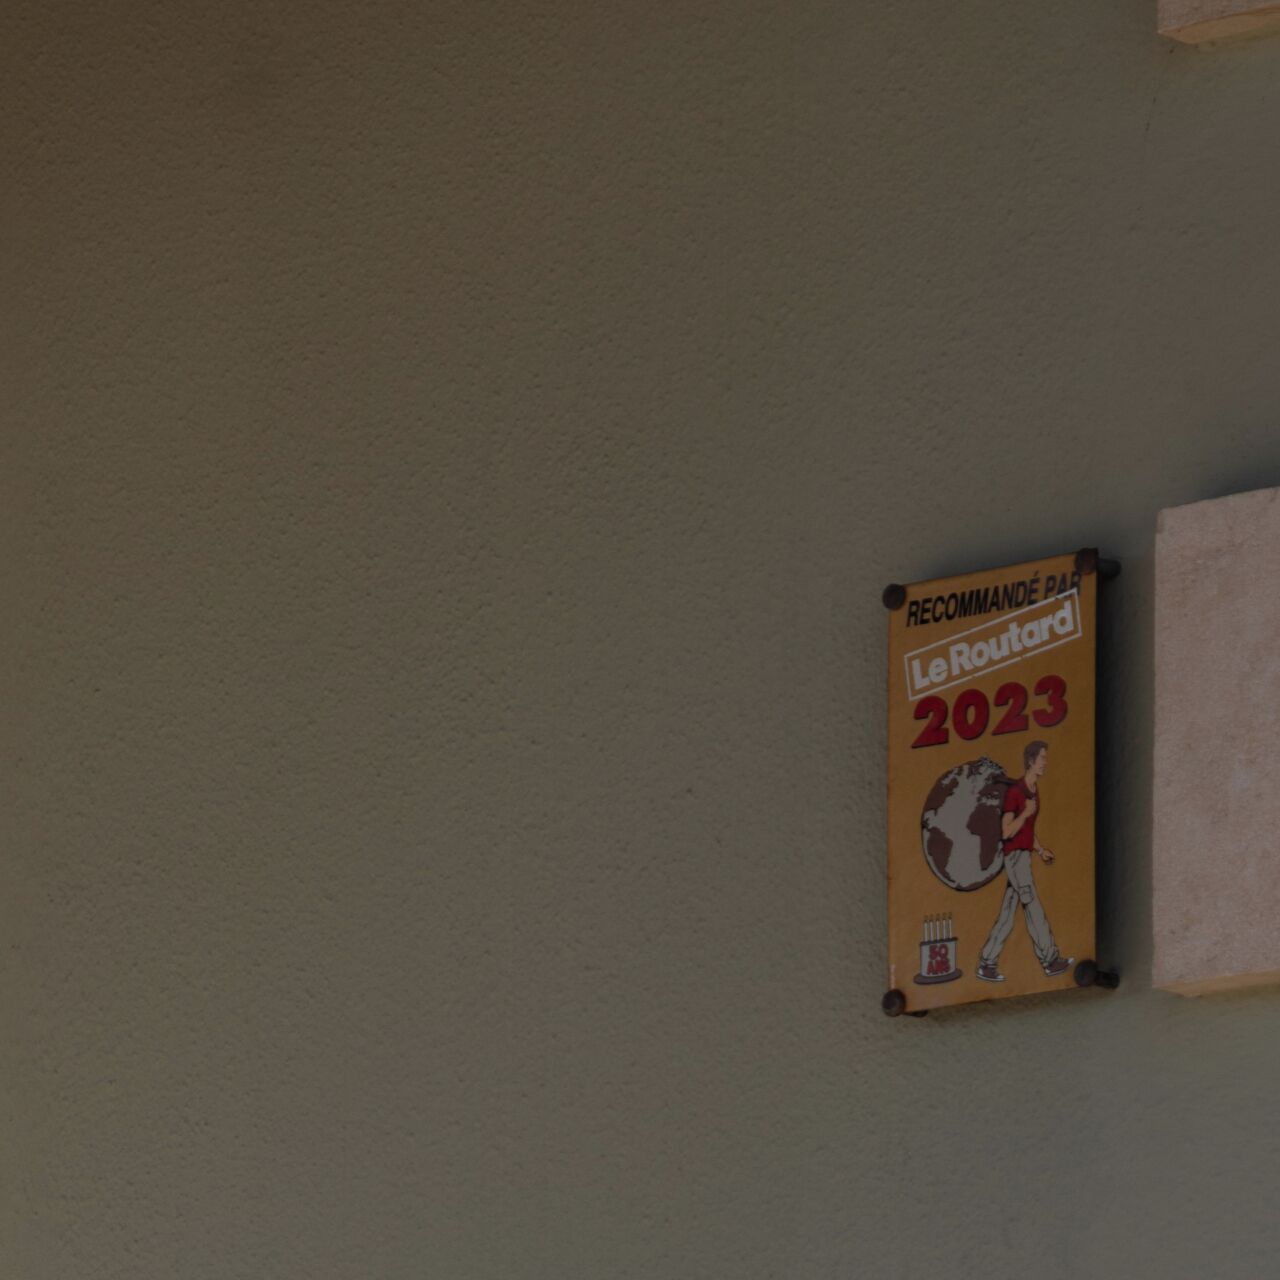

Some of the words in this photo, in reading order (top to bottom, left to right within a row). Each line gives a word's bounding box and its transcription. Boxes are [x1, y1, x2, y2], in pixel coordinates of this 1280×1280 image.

[906, 570, 1041, 628] RECOMMANDÉ
[1044, 570, 1082, 600] PAR
[911, 658, 949, 690] Le
[950, 600, 1074, 676] Routard
[911, 674, 1069, 749] 2023
[928, 943, 949, 961] 50
